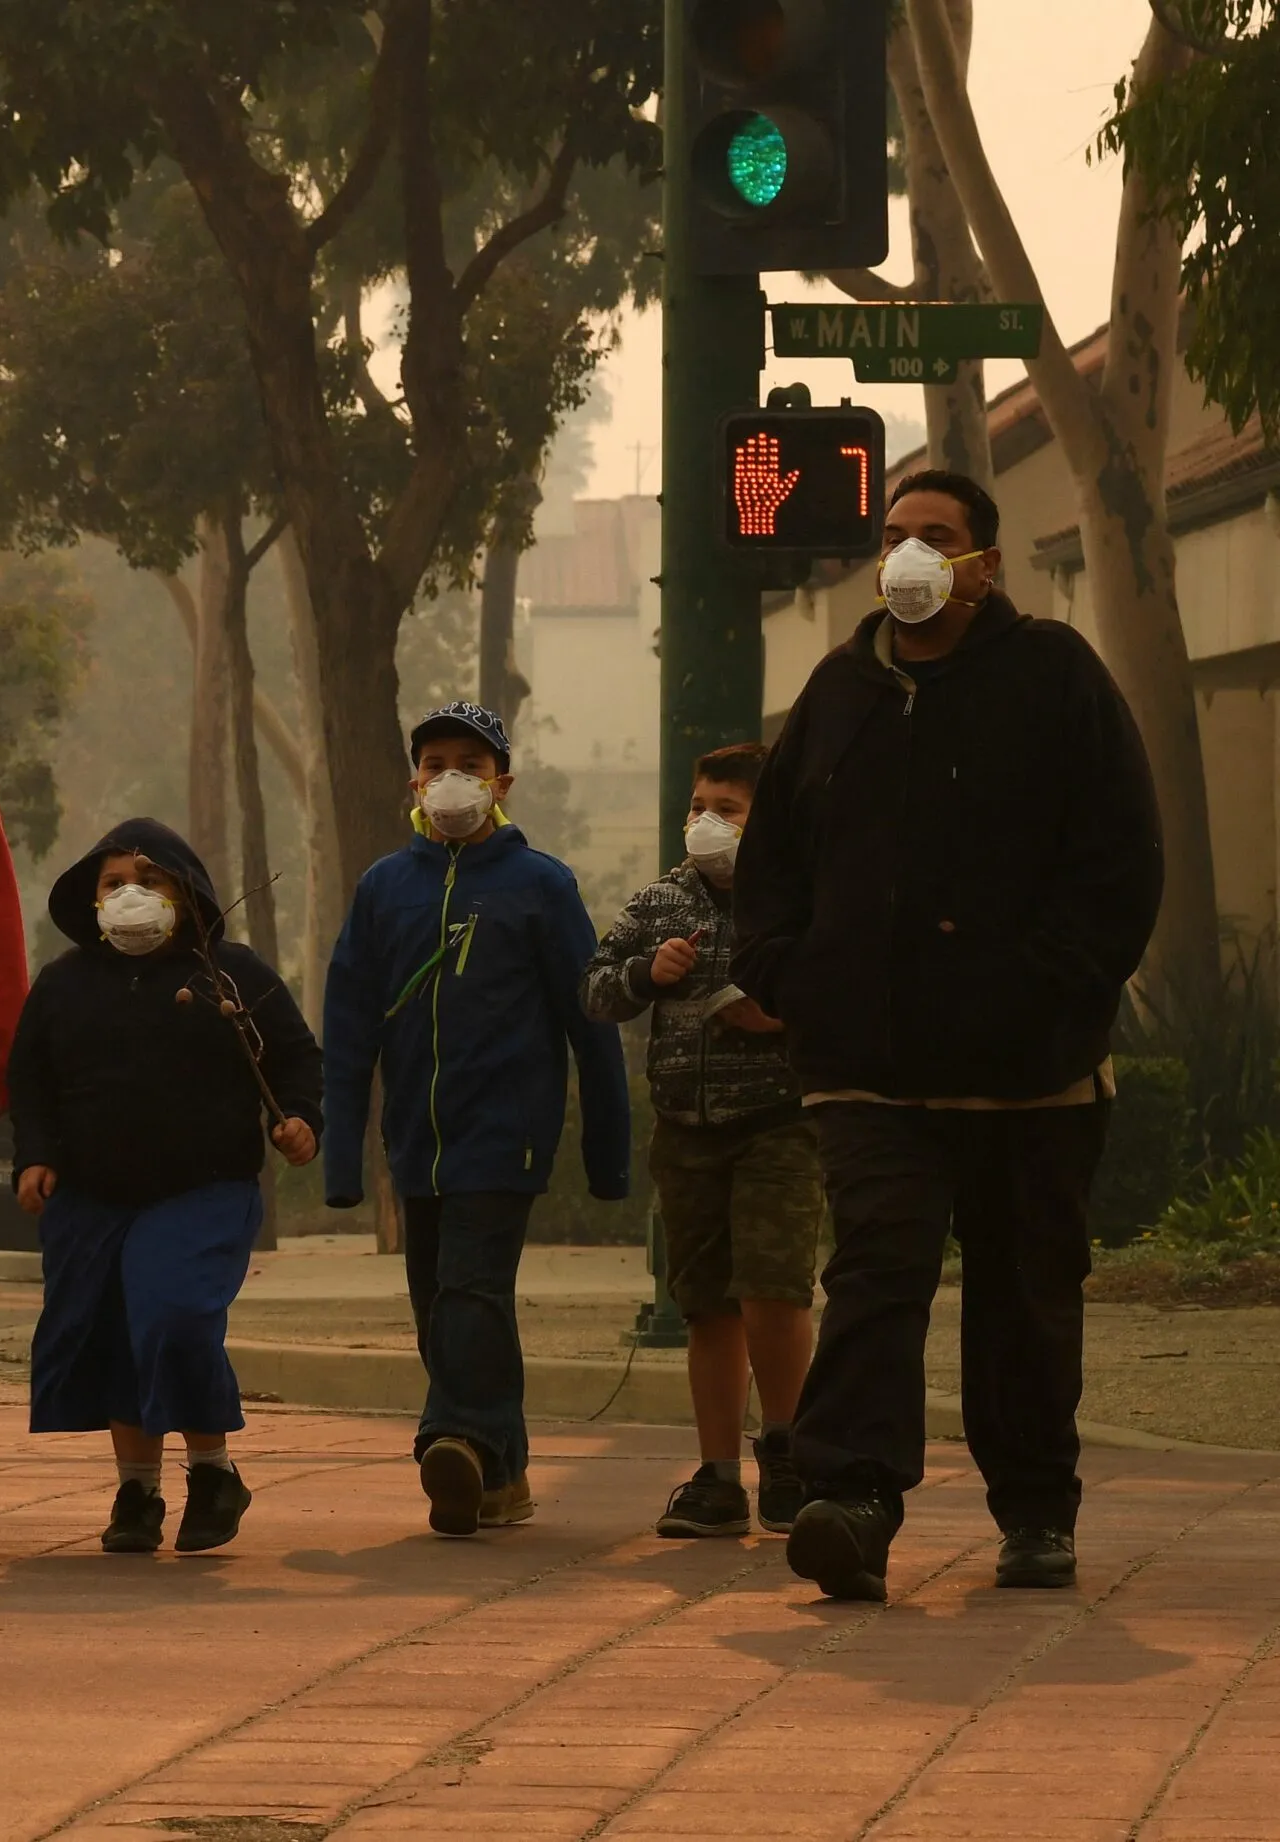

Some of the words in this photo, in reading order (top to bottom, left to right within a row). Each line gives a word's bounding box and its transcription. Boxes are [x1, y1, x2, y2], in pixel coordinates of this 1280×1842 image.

[789, 317, 809, 339] W.
[817, 309, 920, 348] MAIN
[999, 310, 1024, 331] ST.
[889, 357, 923, 378] 100
[840, 446, 869, 516] 7
